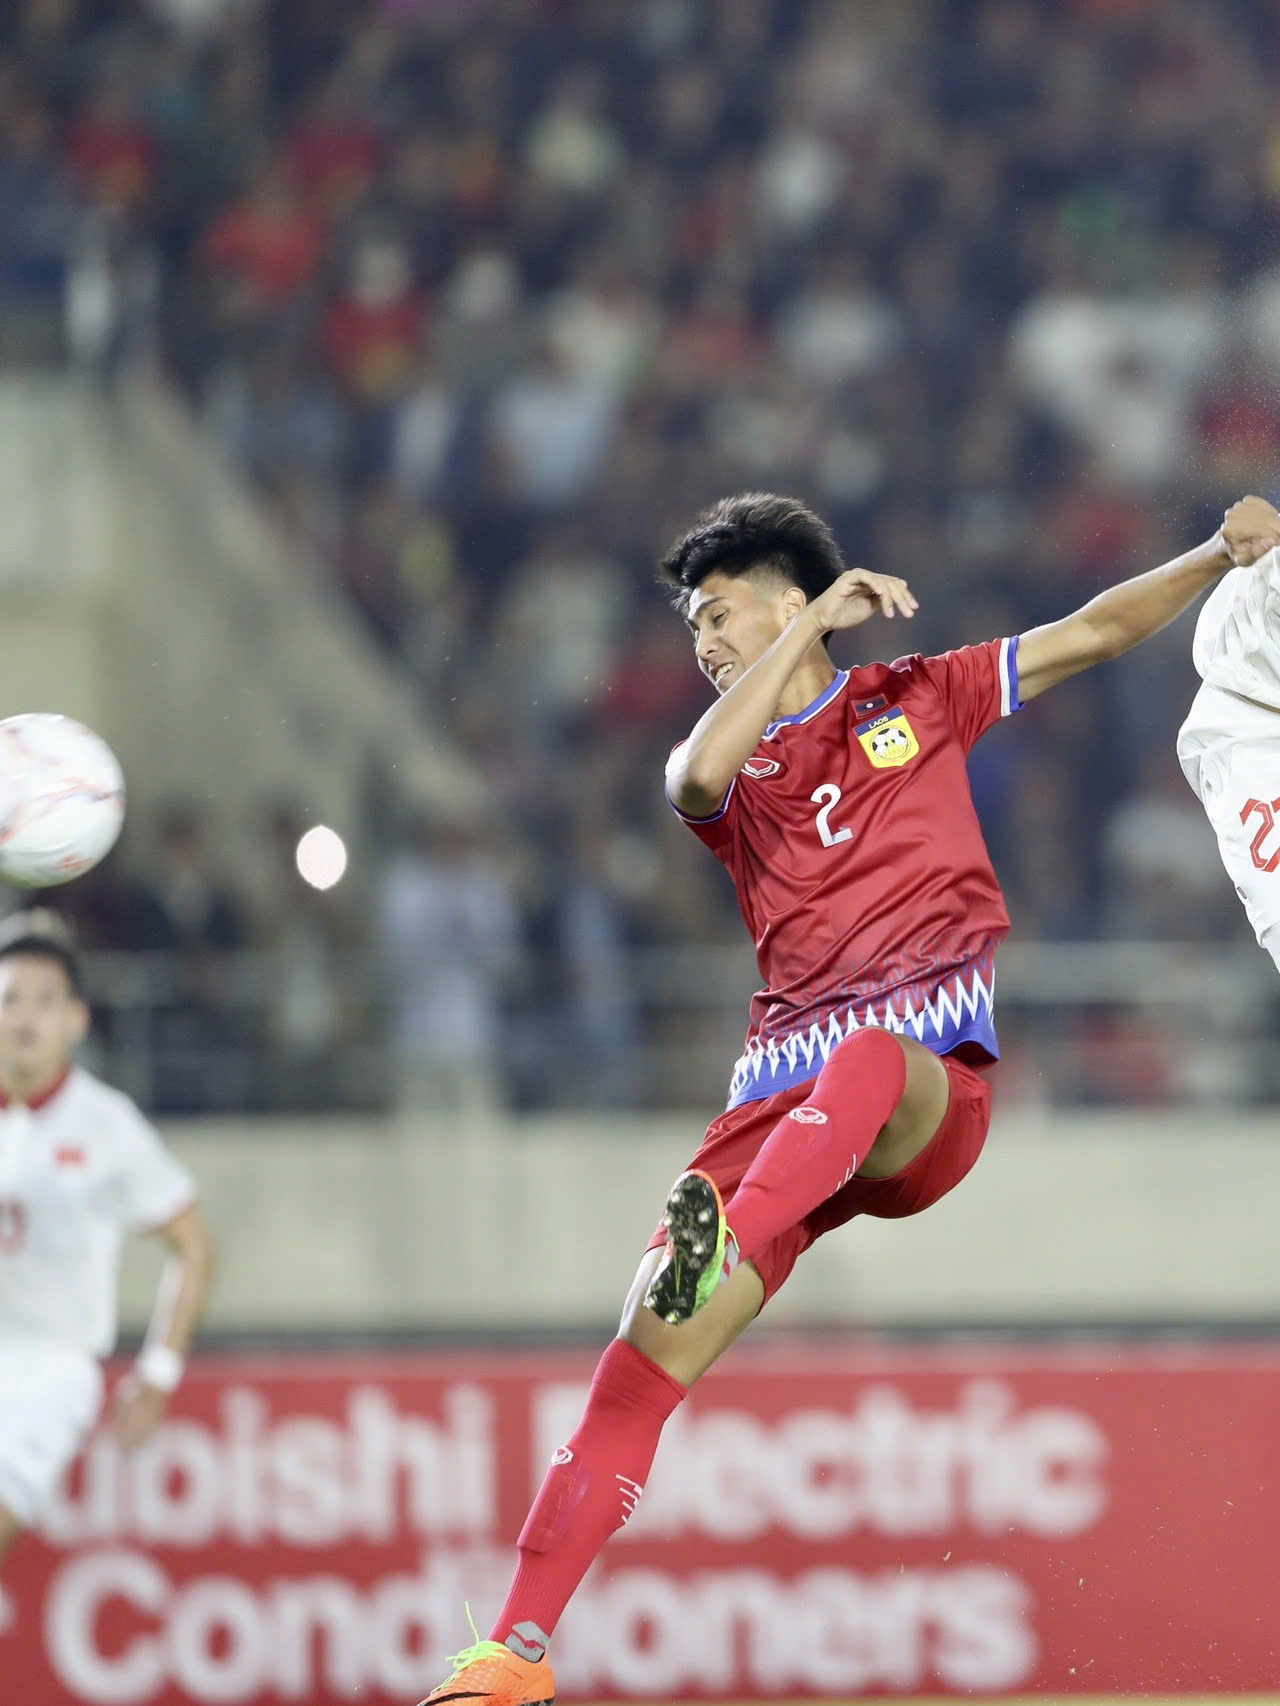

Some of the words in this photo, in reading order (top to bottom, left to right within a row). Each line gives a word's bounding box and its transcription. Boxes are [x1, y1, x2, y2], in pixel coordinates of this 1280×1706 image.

[868, 715, 889, 729] LAOS
[810, 783, 854, 848] 2
[48, 1549, 1040, 1699] Condiioners
